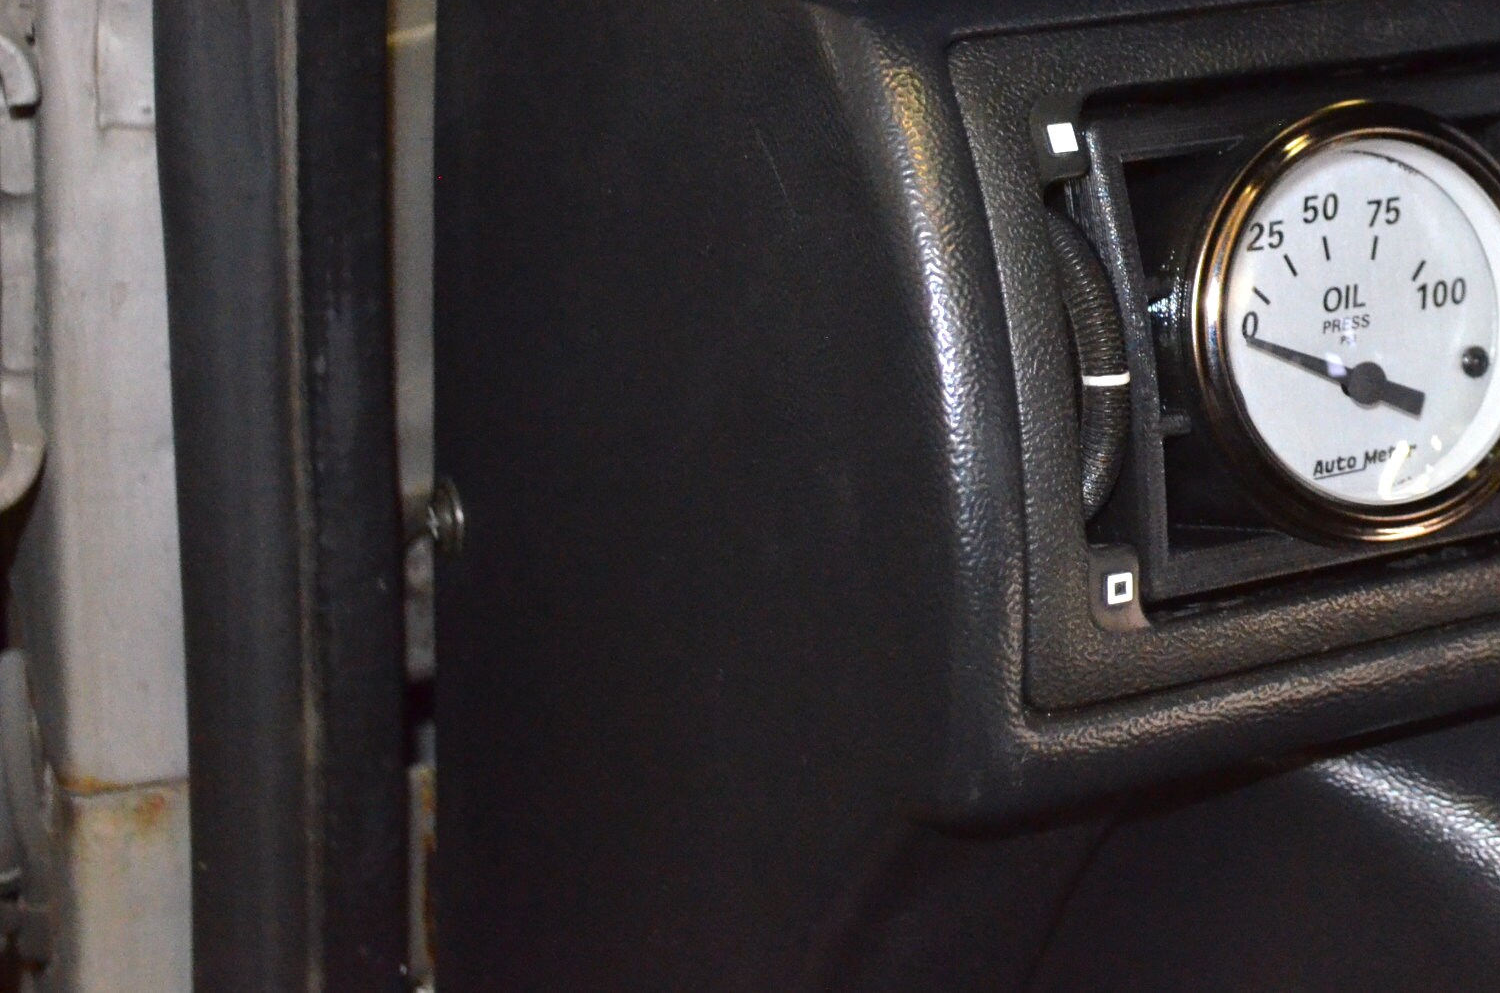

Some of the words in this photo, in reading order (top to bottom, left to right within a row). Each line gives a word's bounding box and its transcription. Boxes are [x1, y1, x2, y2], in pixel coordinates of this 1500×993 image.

[1303, 193, 1339, 224] 50
[1367, 197, 1401, 228] 75
[1246, 221, 1285, 252] 25
[1322, 283, 1367, 313] OIL
[1417, 277, 1467, 311] 100
[1242, 310, 1259, 340] 0
[1322, 313, 1371, 335] PRESS
[1313, 455, 1357, 477] Auto
[1364, 443, 1417, 468] Metr
